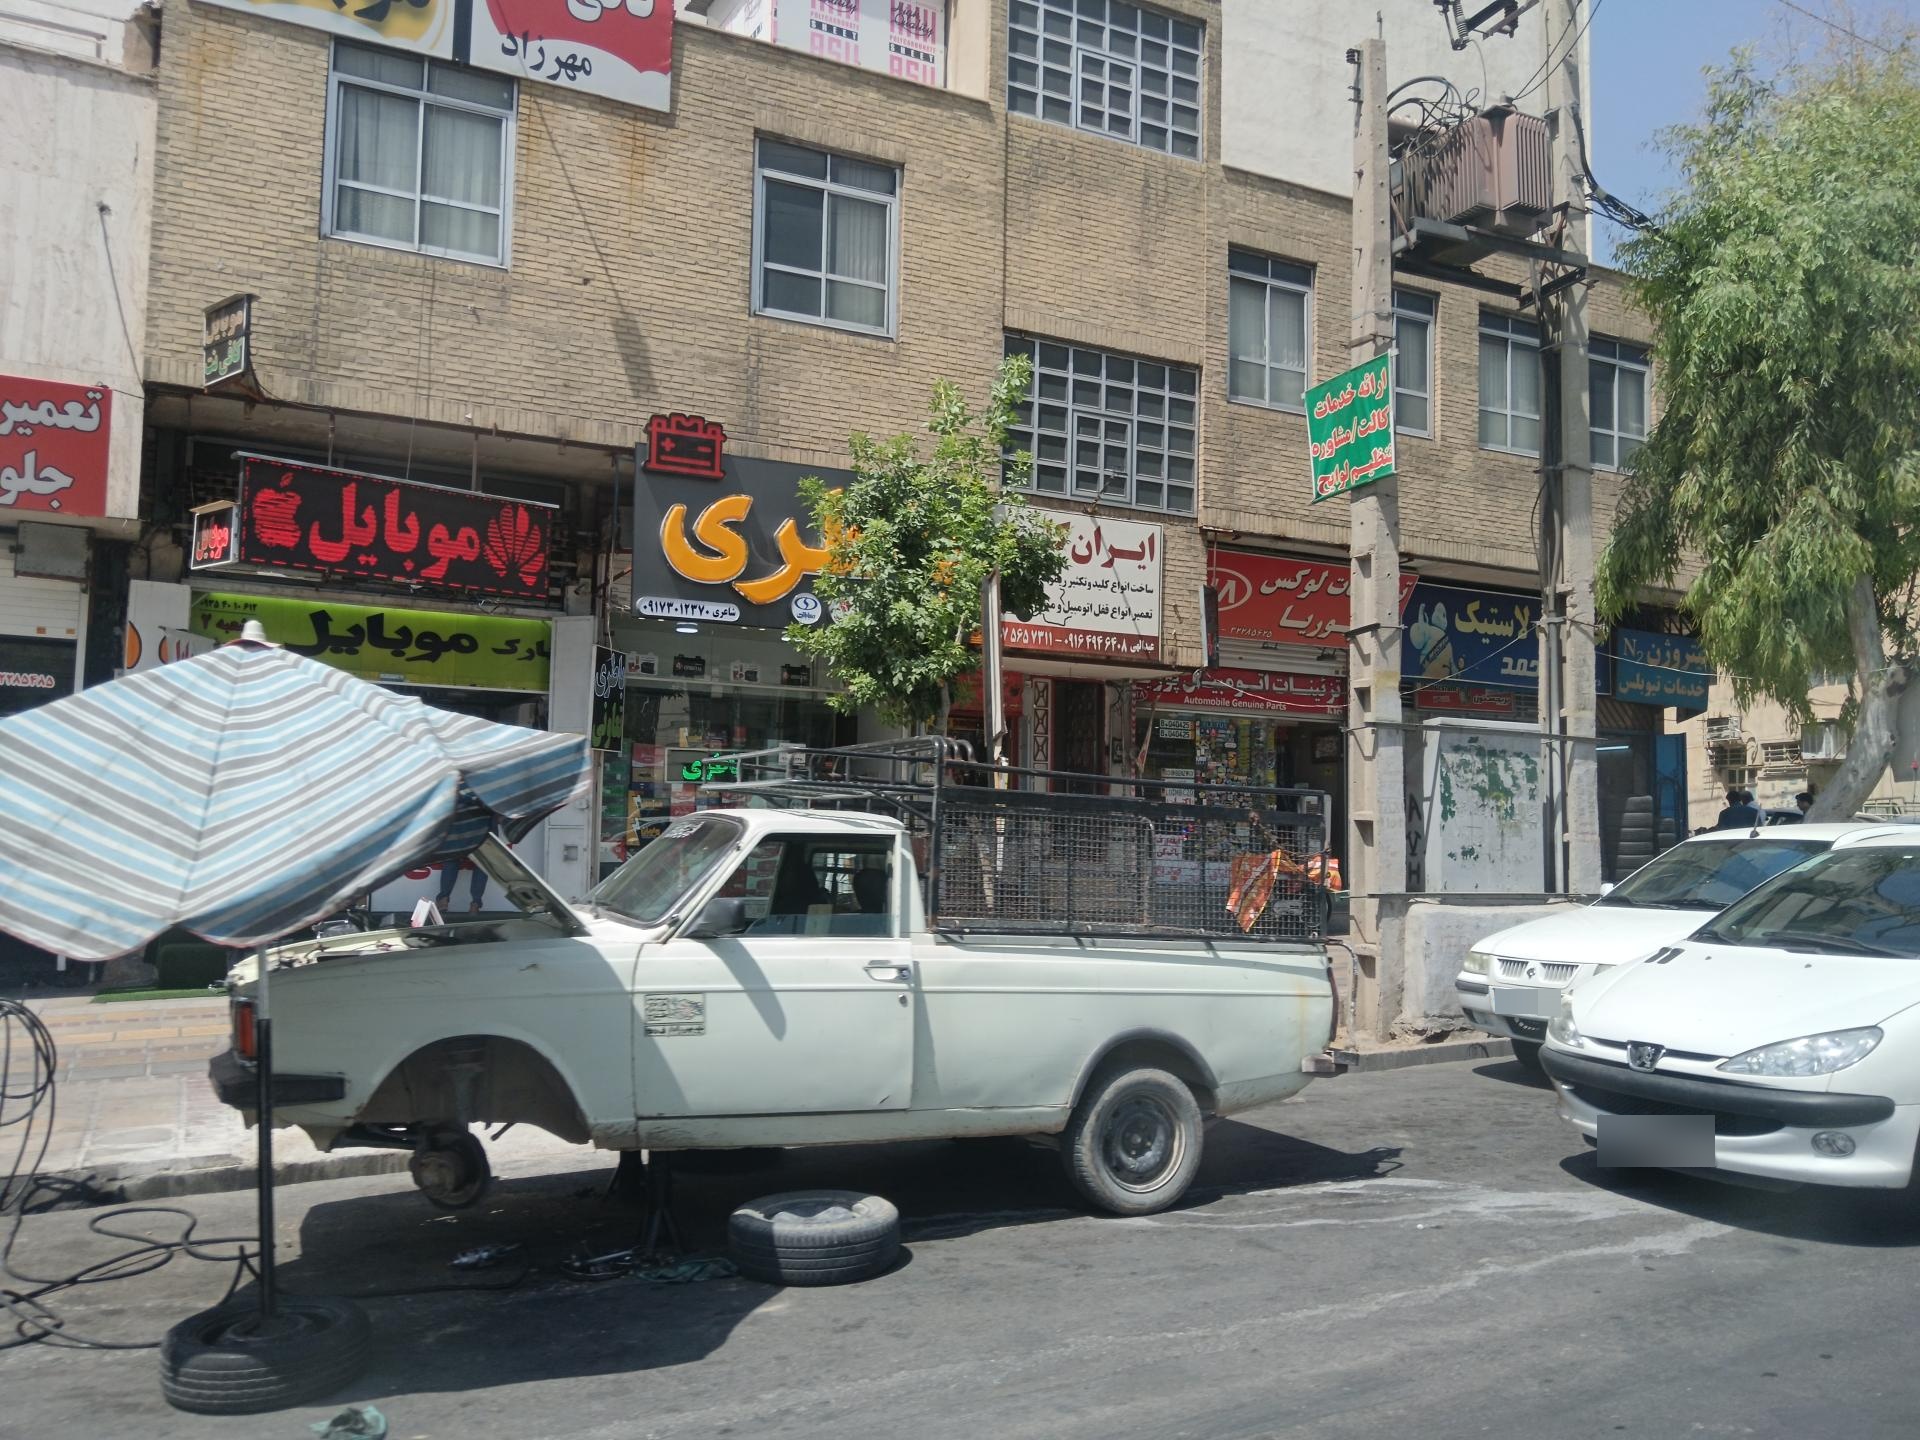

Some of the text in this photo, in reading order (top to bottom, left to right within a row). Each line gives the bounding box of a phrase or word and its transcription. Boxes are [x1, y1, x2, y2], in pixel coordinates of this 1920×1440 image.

[811, 19, 858, 41] SHEET
[889, 43, 934, 63] SHEET
[0, 390, 103, 436] تعمیر
[1314, 382, 1356, 420] خدمات
[308, 482, 481, 579] موبایل
[1071, 524, 1155, 570] ایران
[1258, 567, 1329, 599] لوکس
[286, 610, 551, 663] ارک موبایل
[1279, 604, 1351, 639] وریا
[1455, 600, 1530, 644] لاستیک
[1184, 695, 1287, 711] Automobile Genuine Parts
[1662, 677, 1705, 697] خدمات
